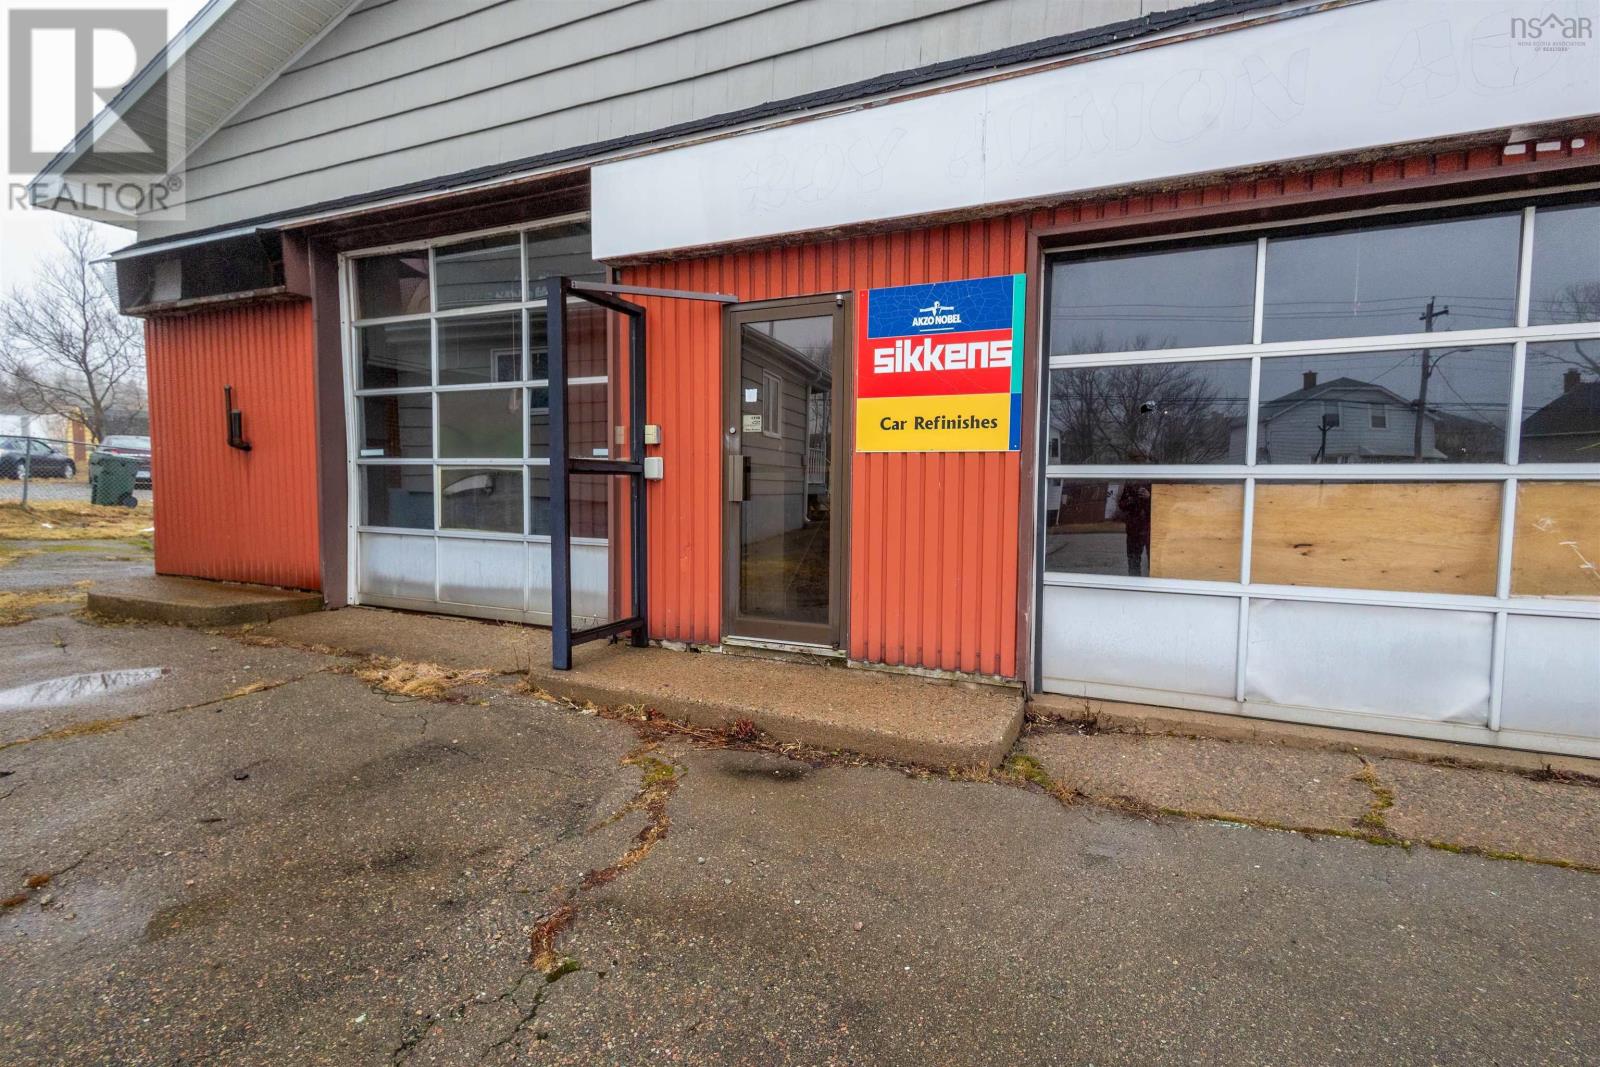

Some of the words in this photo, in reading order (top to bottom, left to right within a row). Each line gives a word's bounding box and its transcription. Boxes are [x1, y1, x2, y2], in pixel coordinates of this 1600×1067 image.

[912, 316, 935, 327] AKZO
[935, 313, 962, 325] NOBEL
[873, 337, 1013, 374] sikkens
[880, 416, 908, 431] Car
[914, 414, 998, 430] Refinishes
